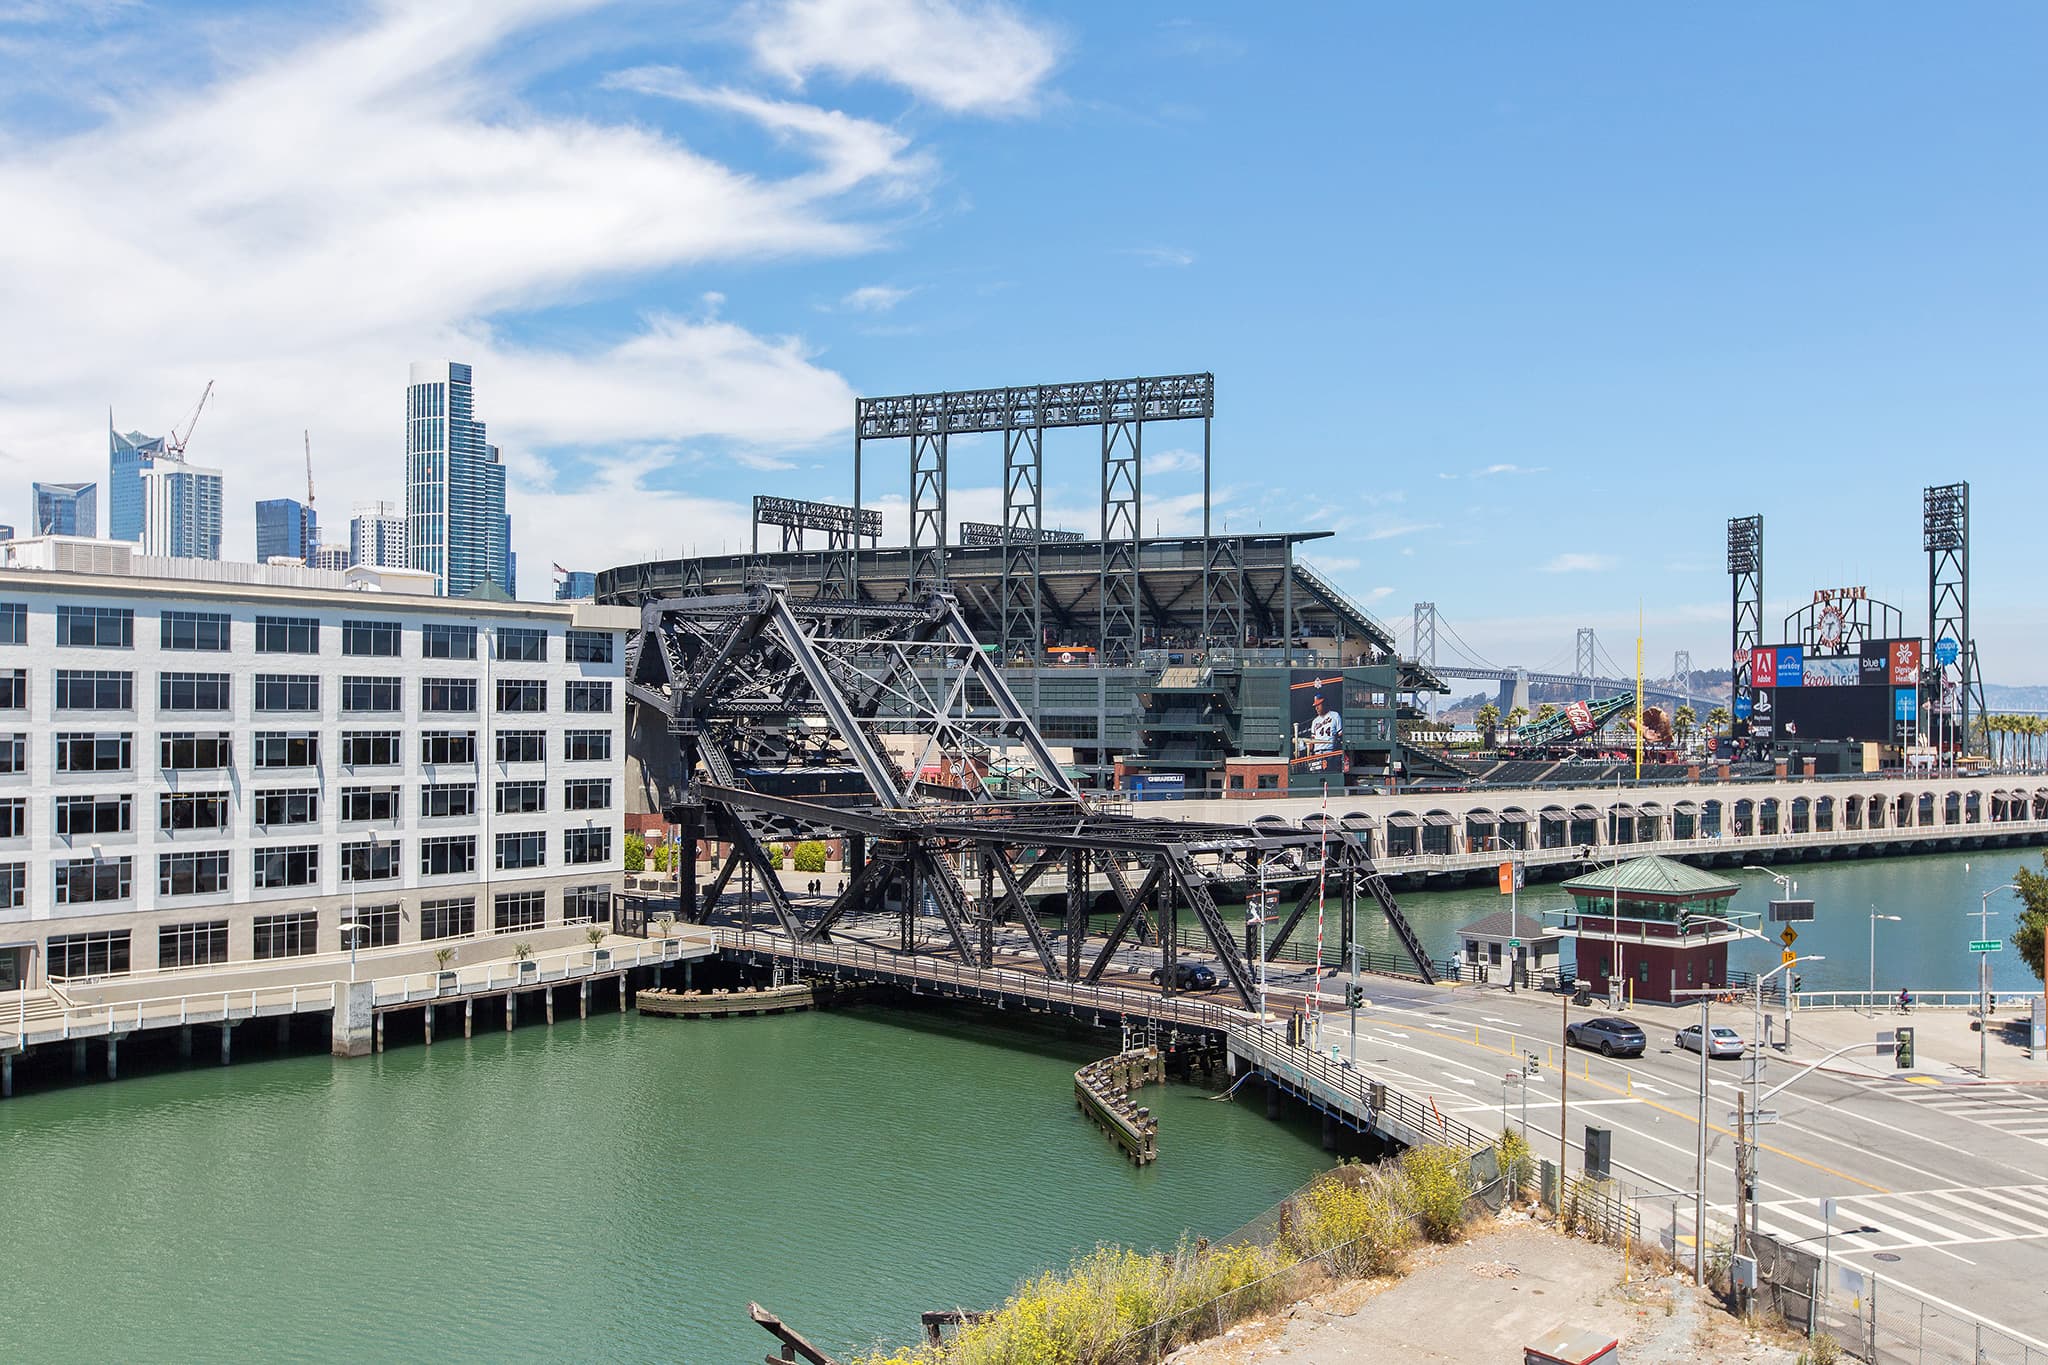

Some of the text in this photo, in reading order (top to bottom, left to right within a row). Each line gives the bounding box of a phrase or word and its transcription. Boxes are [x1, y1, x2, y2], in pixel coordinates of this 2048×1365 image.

[1840, 586, 1866, 600] PARK
[1778, 662, 1801, 671] workday
[1862, 658, 1880, 668] blue
[1757, 675, 1771, 683] Adobe
[1802, 670, 1860, 687] Coors LIGHT
[1319, 726, 1331, 737] 44
[1410, 731, 1480, 742] nuveen
[1785, 953, 1794, 961] 15
